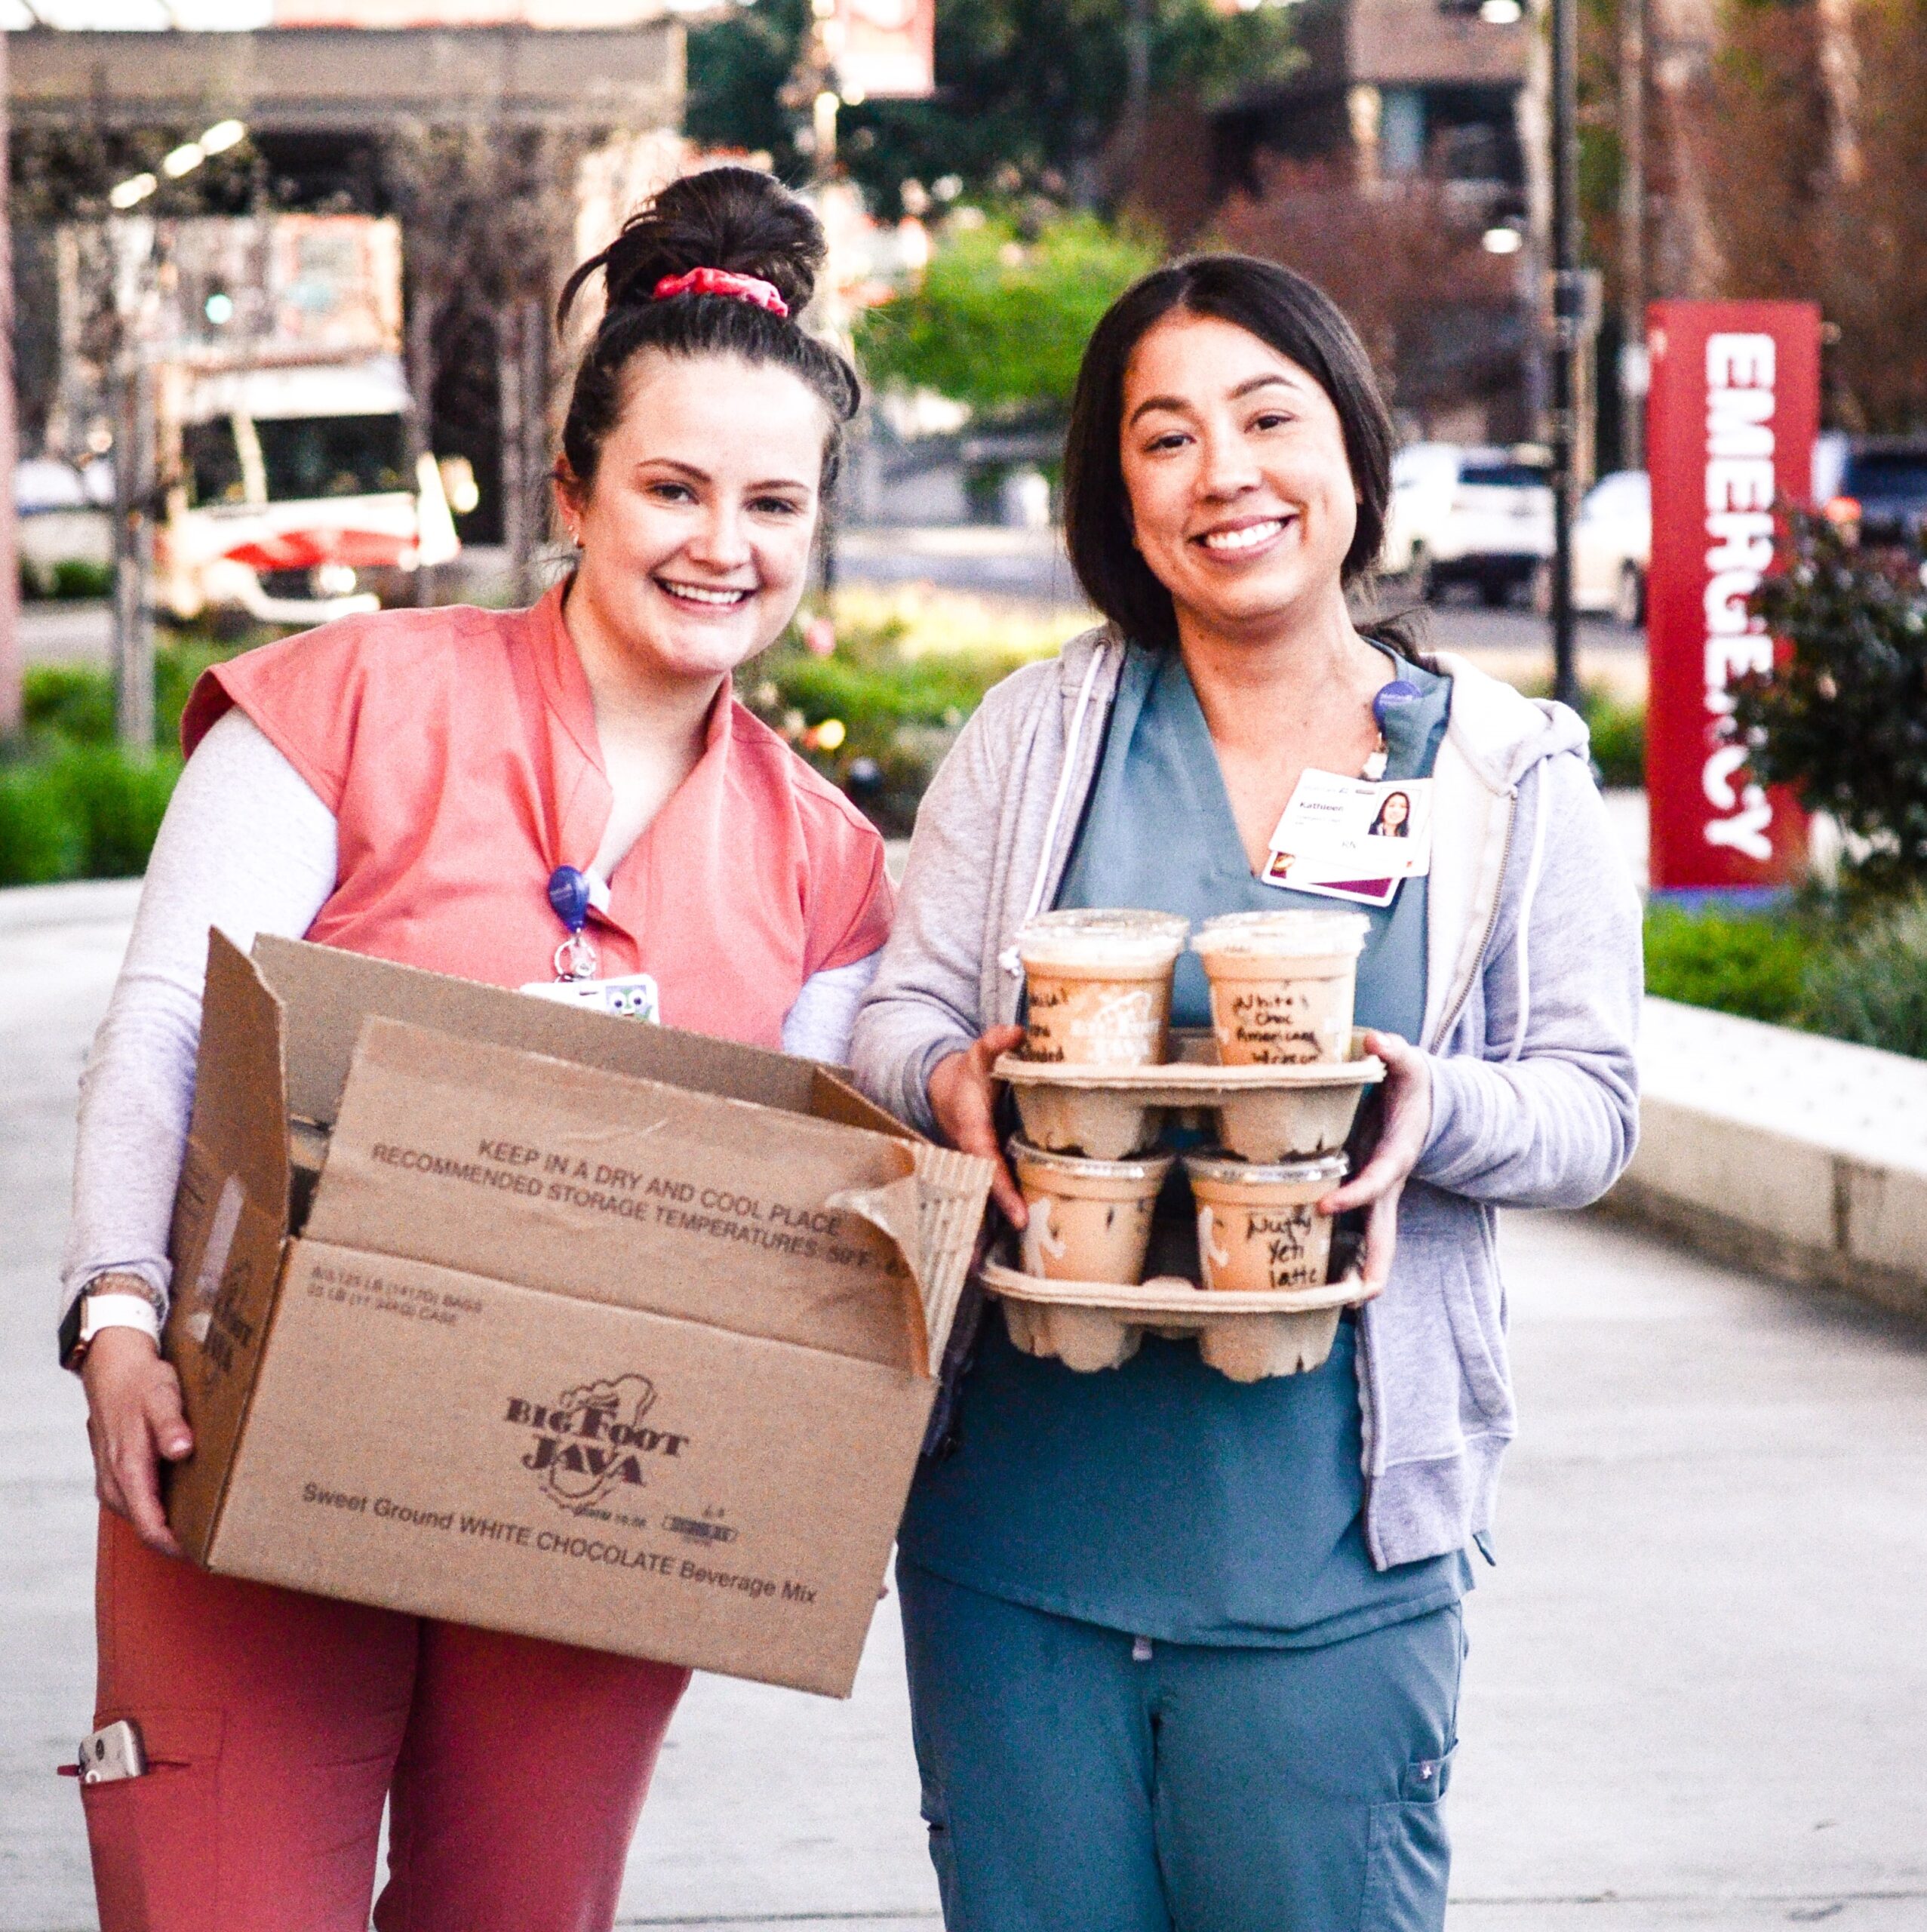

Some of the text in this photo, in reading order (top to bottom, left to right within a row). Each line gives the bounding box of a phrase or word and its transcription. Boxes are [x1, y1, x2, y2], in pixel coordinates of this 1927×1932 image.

[1704, 331, 1776, 860] EMERGECY
[372, 1142, 544, 1198] RECOMMENDED
[547, 1183, 647, 1222] STORAGE
[655, 1207, 818, 1259] TEMPERATURES
[478, 1139, 844, 1238] KEEP IN A DRY AND COOL PLACE
[521, 1432, 647, 1487] JAVA
[303, 1481, 367, 1512] Sweet
[373, 1497, 453, 1531] Ground
[459, 1514, 532, 1546] WHITE
[536, 1531, 676, 1576] CHOCOLATE
[680, 1560, 776, 1598] Beverage
[781, 1579, 817, 1604] Mix
